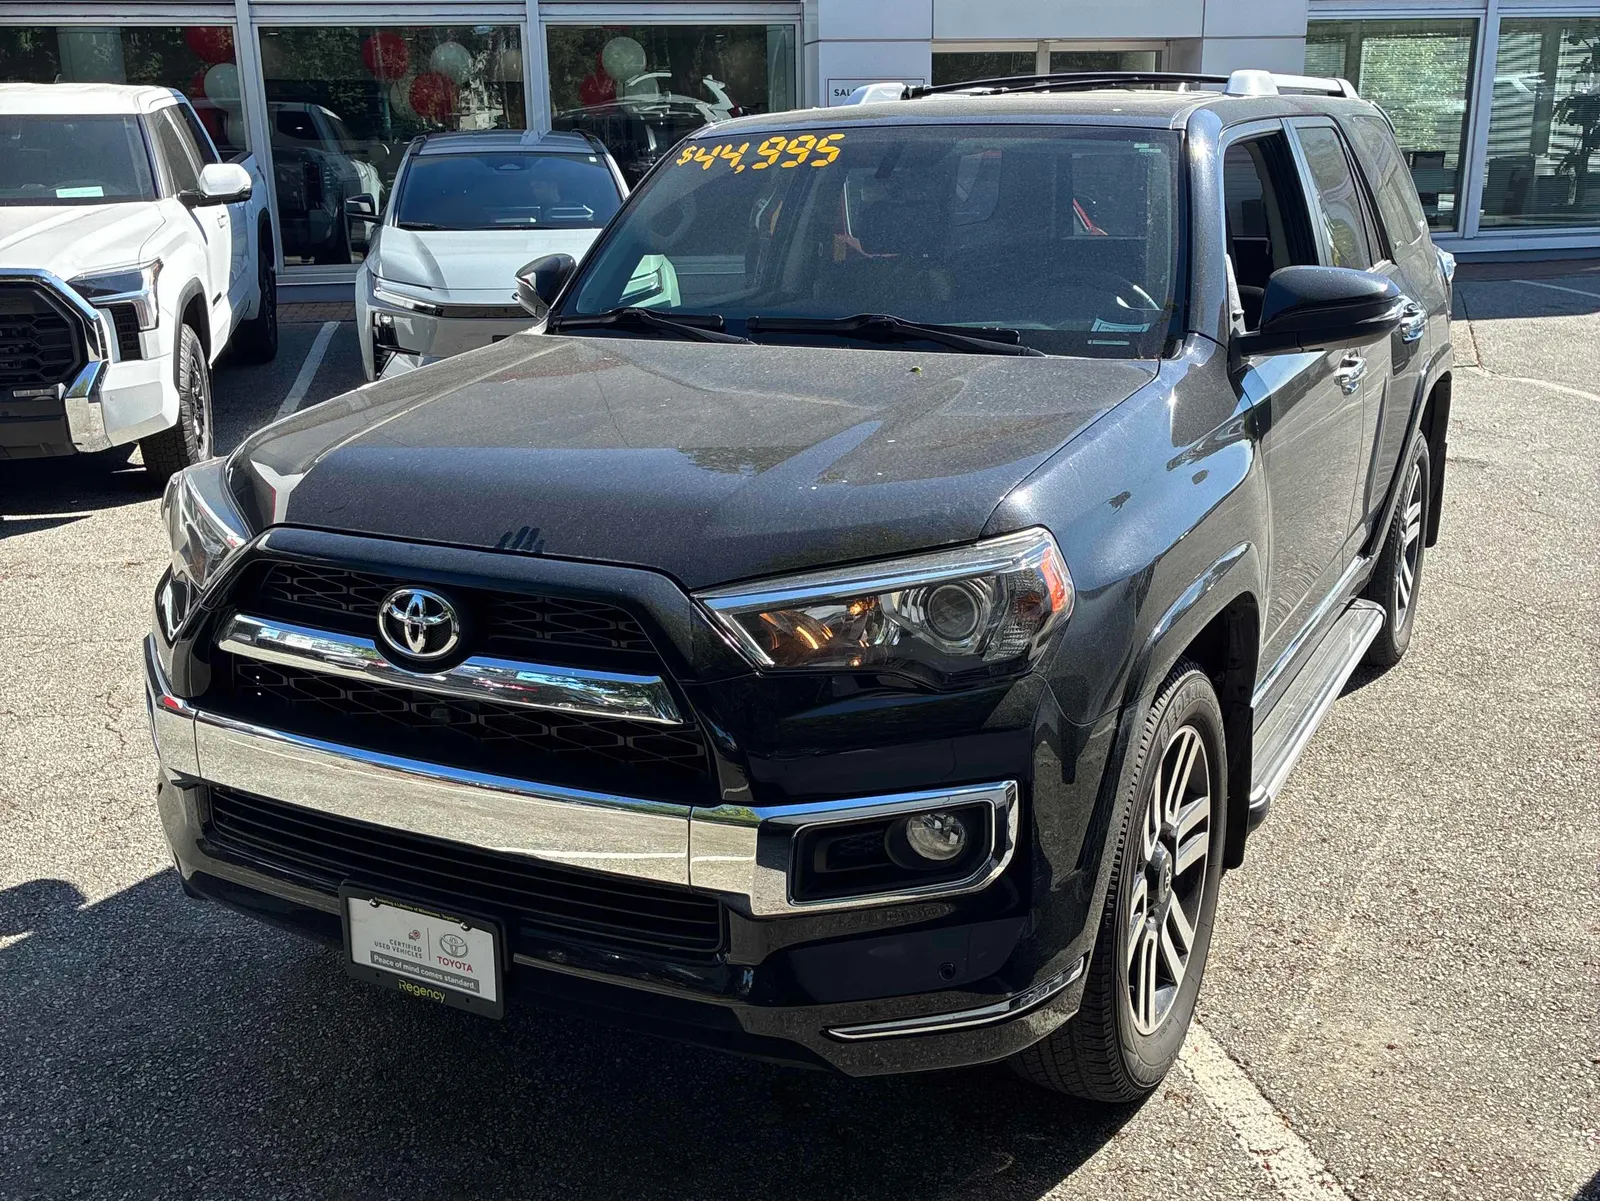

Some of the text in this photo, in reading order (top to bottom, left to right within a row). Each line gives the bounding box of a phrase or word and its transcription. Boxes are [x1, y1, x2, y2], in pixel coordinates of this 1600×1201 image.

[833, 88, 856, 97] SAL
[676, 133, 846, 175] $44,995
[374, 941, 423, 959] USED VEHICLES
[389, 939, 422, 952] CERTIFIED
[373, 955, 393, 967] Peace
[402, 964, 420, 973] mind
[420, 969, 443, 980] comes
[444, 975, 477, 989] standard.
[436, 956, 474, 973] TOYOTA
[398, 979, 446, 1003] Regency
